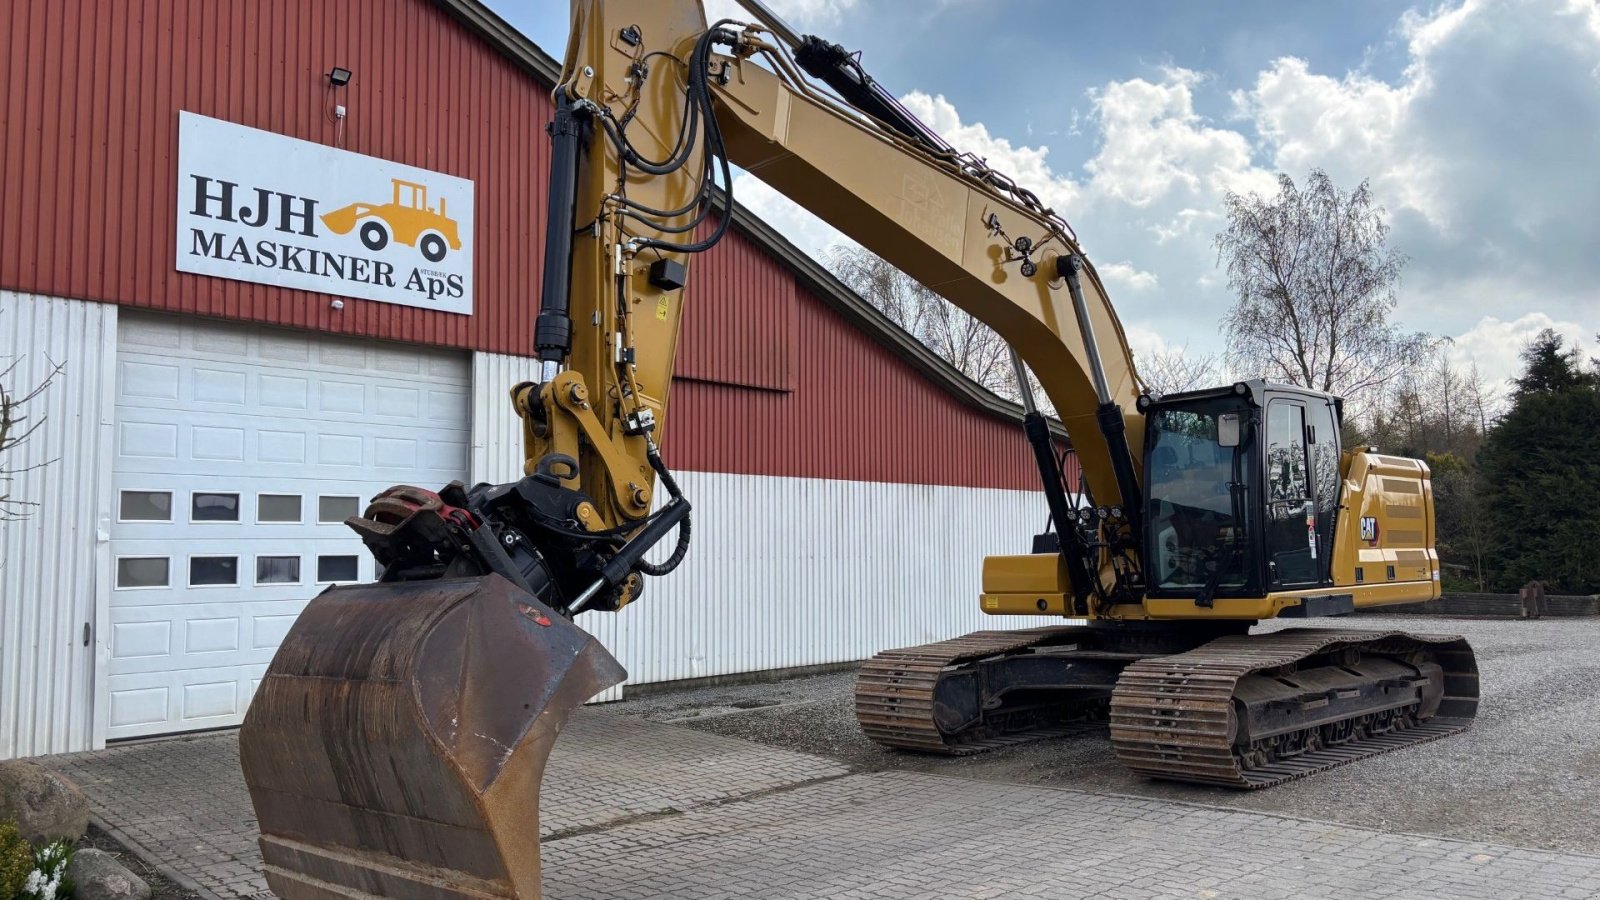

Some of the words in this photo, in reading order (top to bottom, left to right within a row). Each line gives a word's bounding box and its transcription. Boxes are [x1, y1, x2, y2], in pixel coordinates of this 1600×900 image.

[190, 174, 319, 238] HJH
[190, 228, 396, 288] MASKINER
[404, 267, 464, 300] ApS
[1361, 517, 1375, 540] CAT
